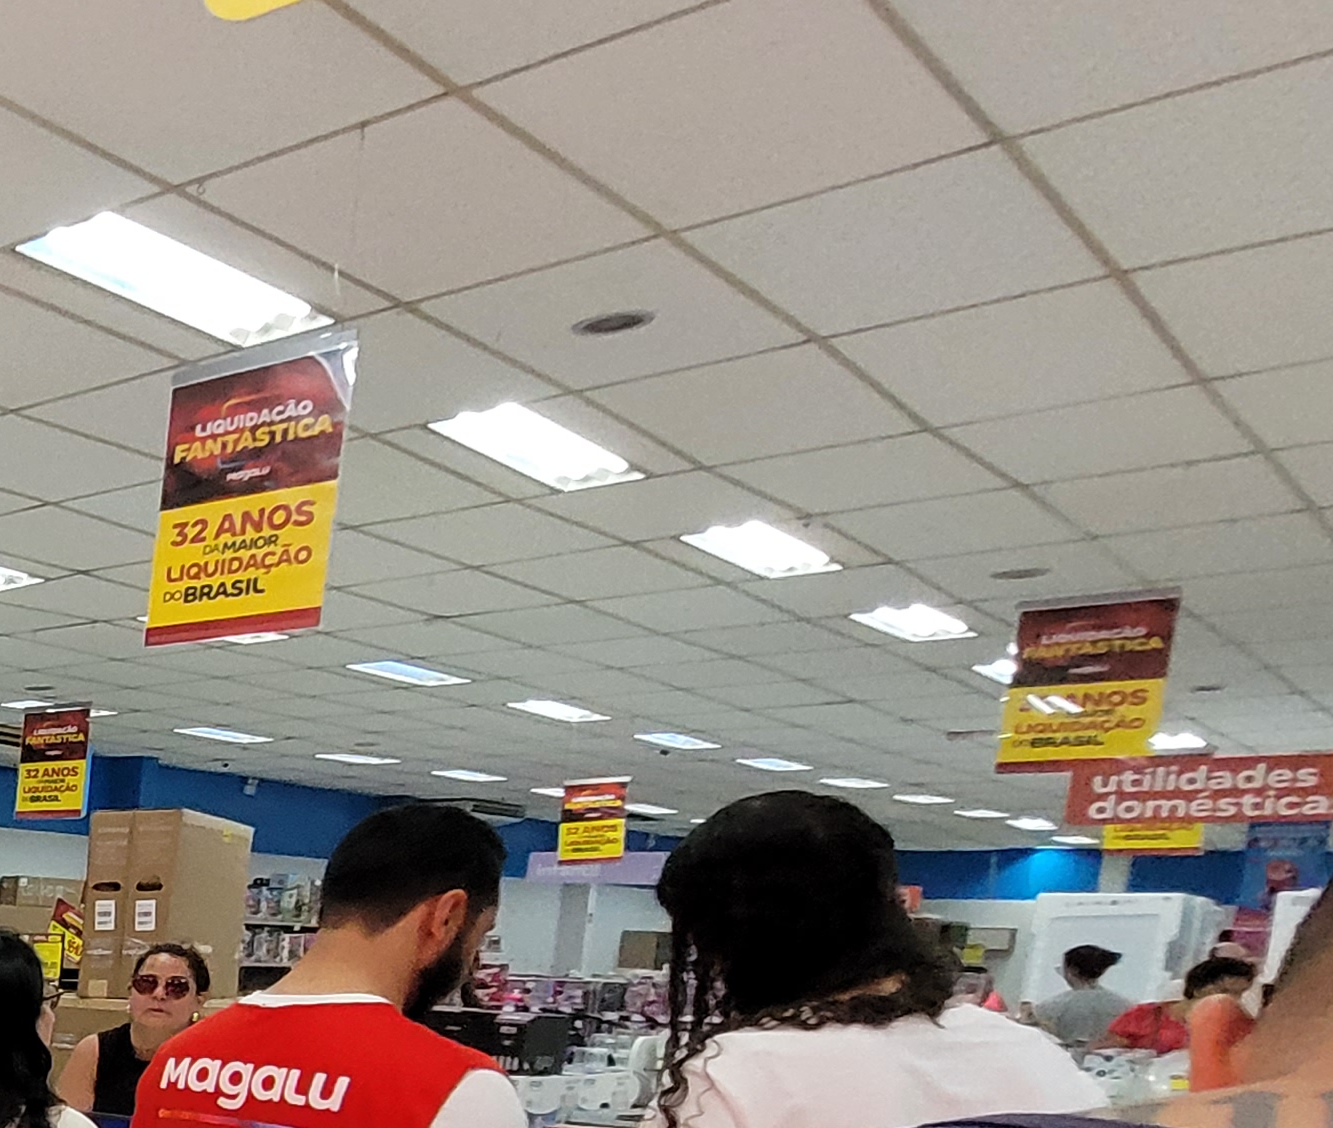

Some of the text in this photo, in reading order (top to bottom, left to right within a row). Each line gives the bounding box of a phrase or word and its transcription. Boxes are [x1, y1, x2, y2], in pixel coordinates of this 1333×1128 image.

[195, 399, 314, 437] LIQUIDAÇÃO
[173, 414, 333, 464] FANTÁSTICA
[170, 500, 315, 547] 32 ANOS
[221, 534, 279, 555] MAIOR
[166, 542, 313, 584] LIQUIDAÇÃO
[163, 576, 265, 604] DO BRASIL
[24, 766, 80, 779] 32 ANOS
[1092, 763, 1320, 794] utilidades
[1088, 791, 1333, 820] doméstica
